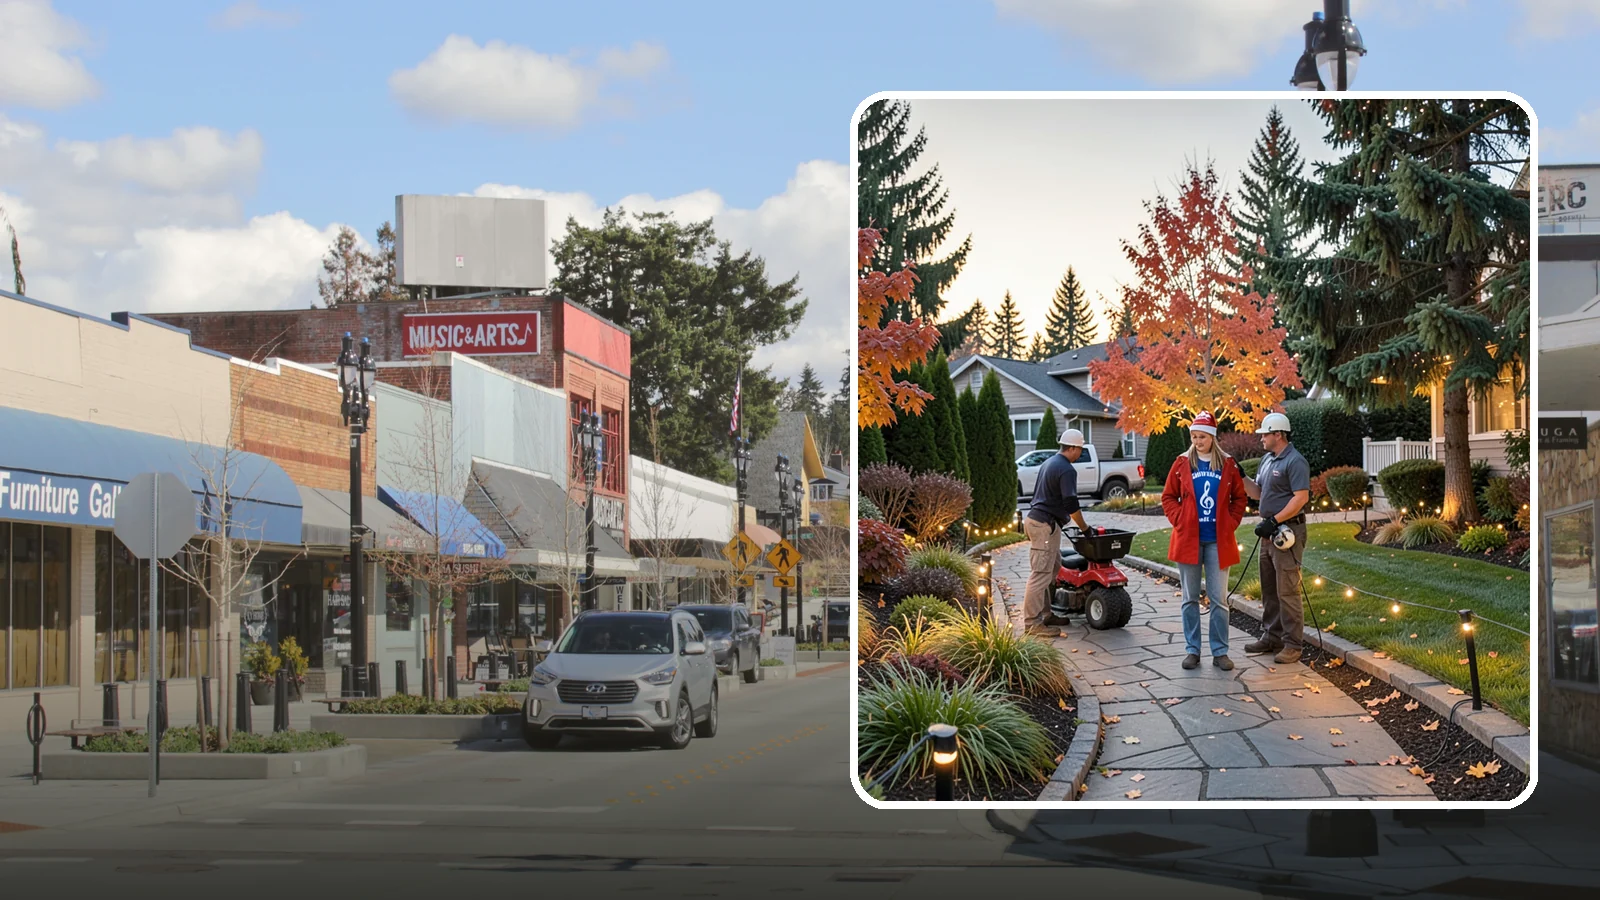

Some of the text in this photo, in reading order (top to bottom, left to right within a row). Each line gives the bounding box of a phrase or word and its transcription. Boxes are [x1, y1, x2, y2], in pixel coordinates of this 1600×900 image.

[408, 323, 520, 349] MUSIC&ARTS
[0, 471, 79, 516] Furniture
[452, 563, 479, 575] SUSHI
